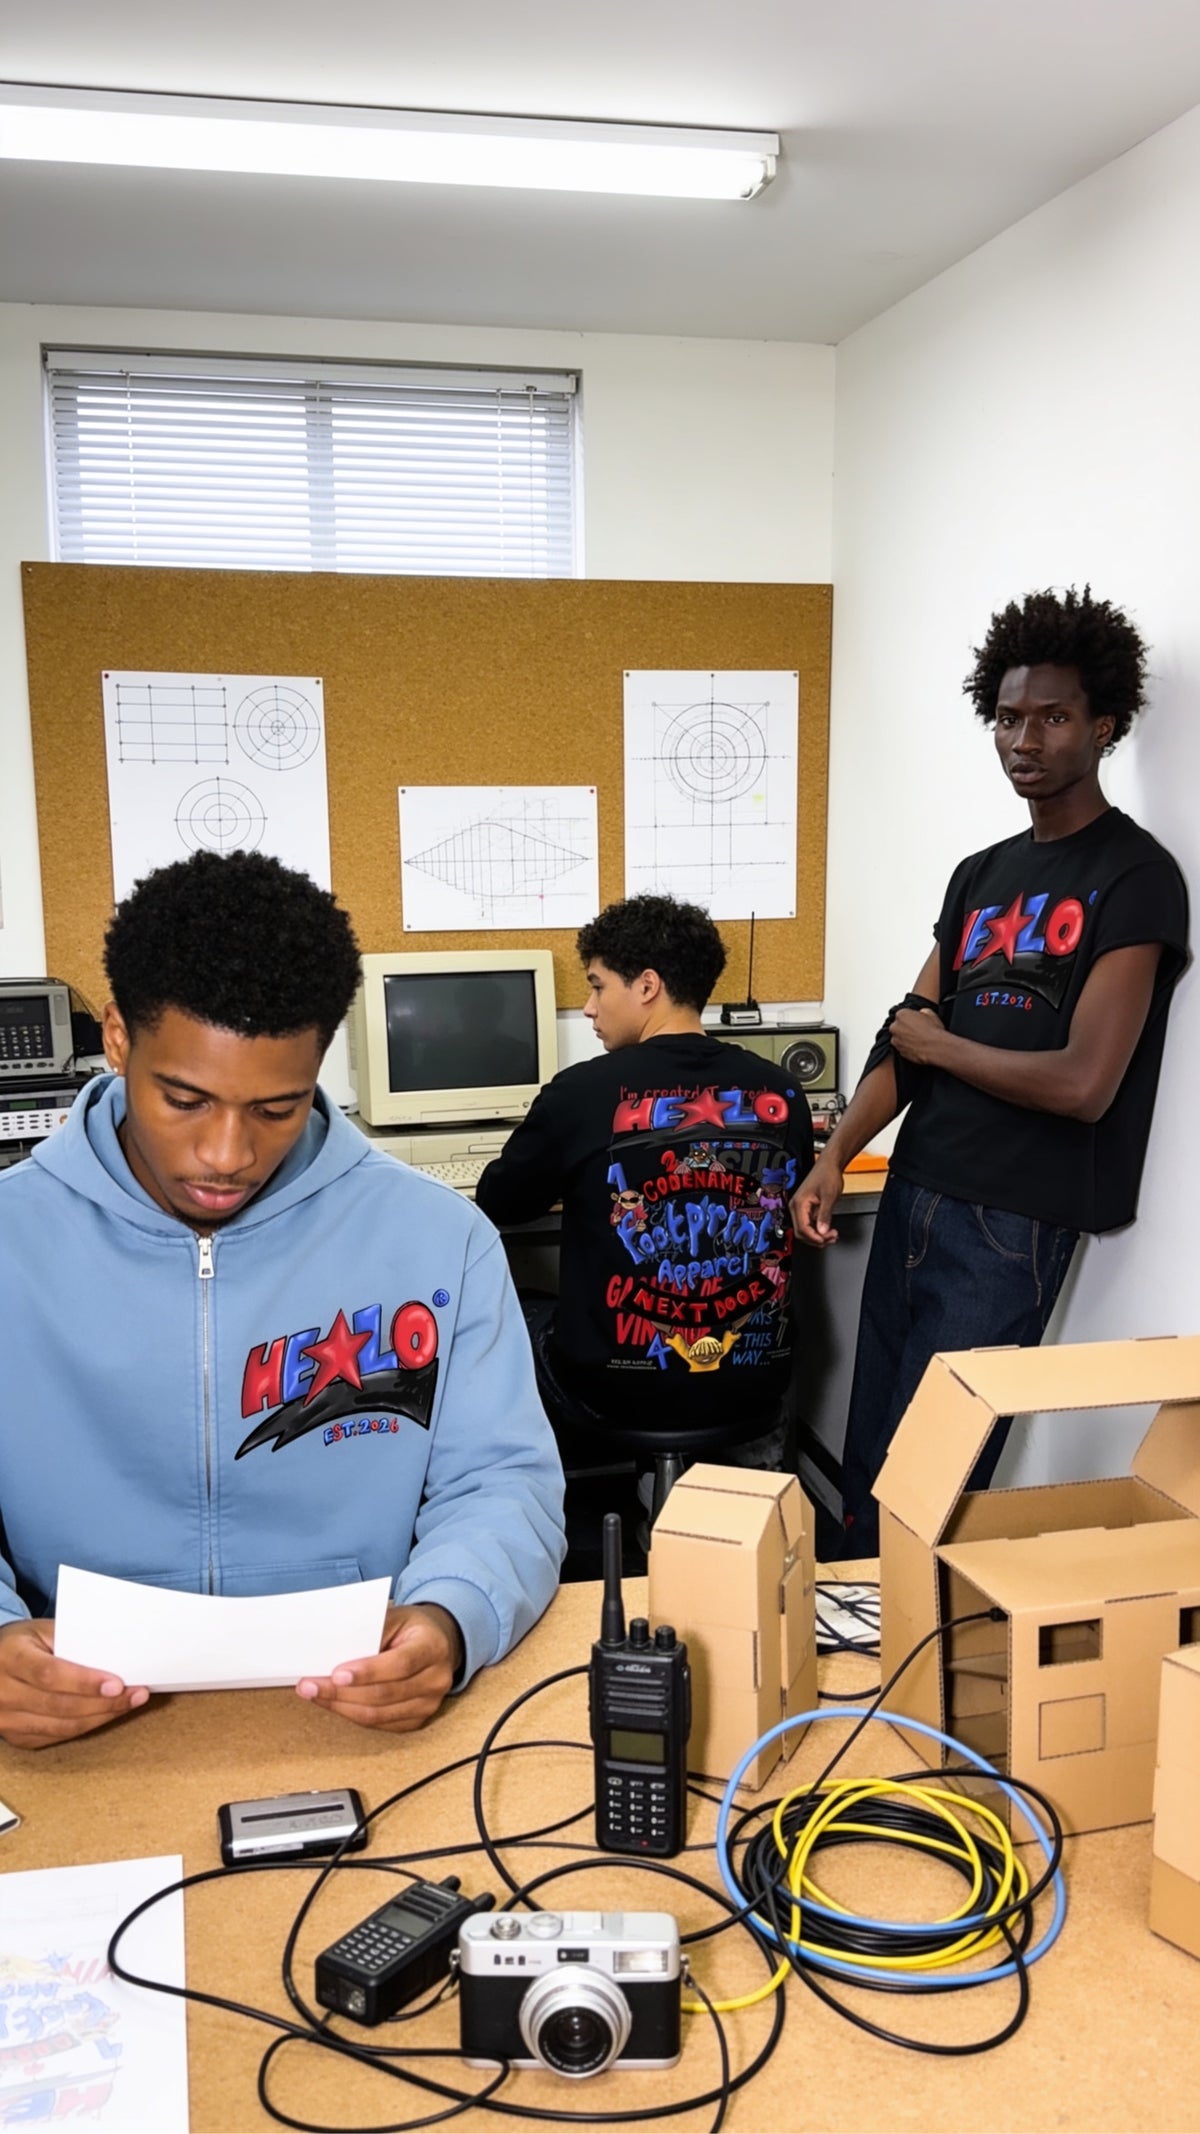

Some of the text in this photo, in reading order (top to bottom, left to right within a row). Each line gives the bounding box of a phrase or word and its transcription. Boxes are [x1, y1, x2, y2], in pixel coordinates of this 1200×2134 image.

[975, 991, 1033, 1011] EST.2026
[658, 1251, 750, 1290] Apparel
[633, 1288, 707, 1323] NEXT
[714, 1280, 766, 1319] DOOR
[646, 1332, 674, 1371] 4
[743, 1332, 773, 1348] THIS
[323, 1417, 400, 1447] EST.2026
